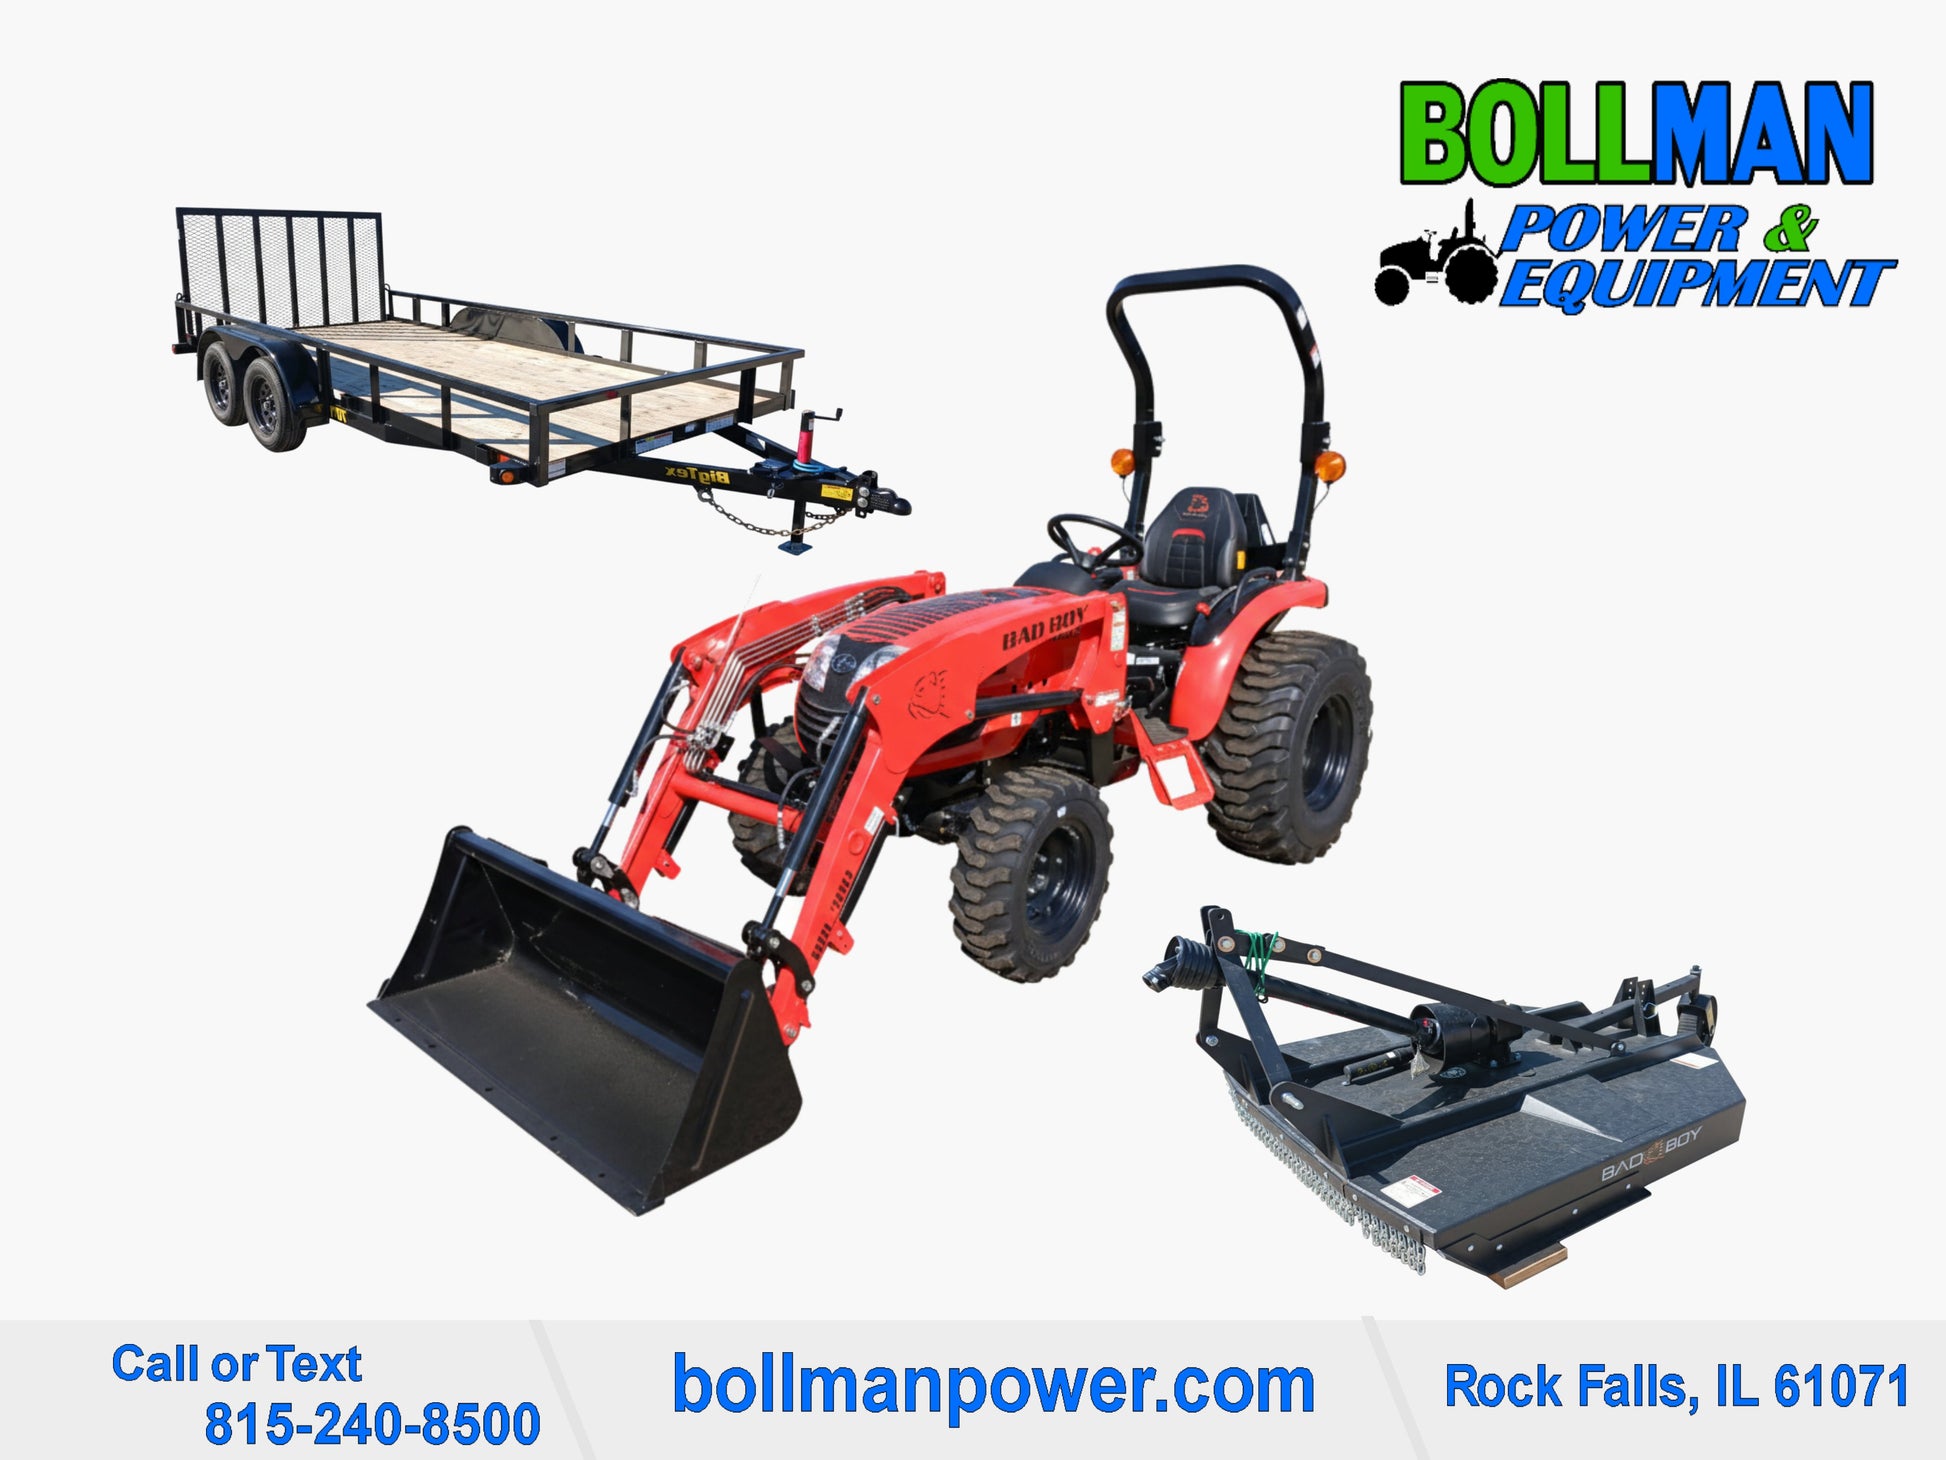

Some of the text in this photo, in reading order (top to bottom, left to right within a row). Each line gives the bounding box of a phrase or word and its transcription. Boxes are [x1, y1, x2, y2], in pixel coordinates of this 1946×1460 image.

[1003, 622, 1045, 651] BAD
[1050, 605, 1089, 633] BOY
[1602, 1125, 1703, 1182] BAD BOY
